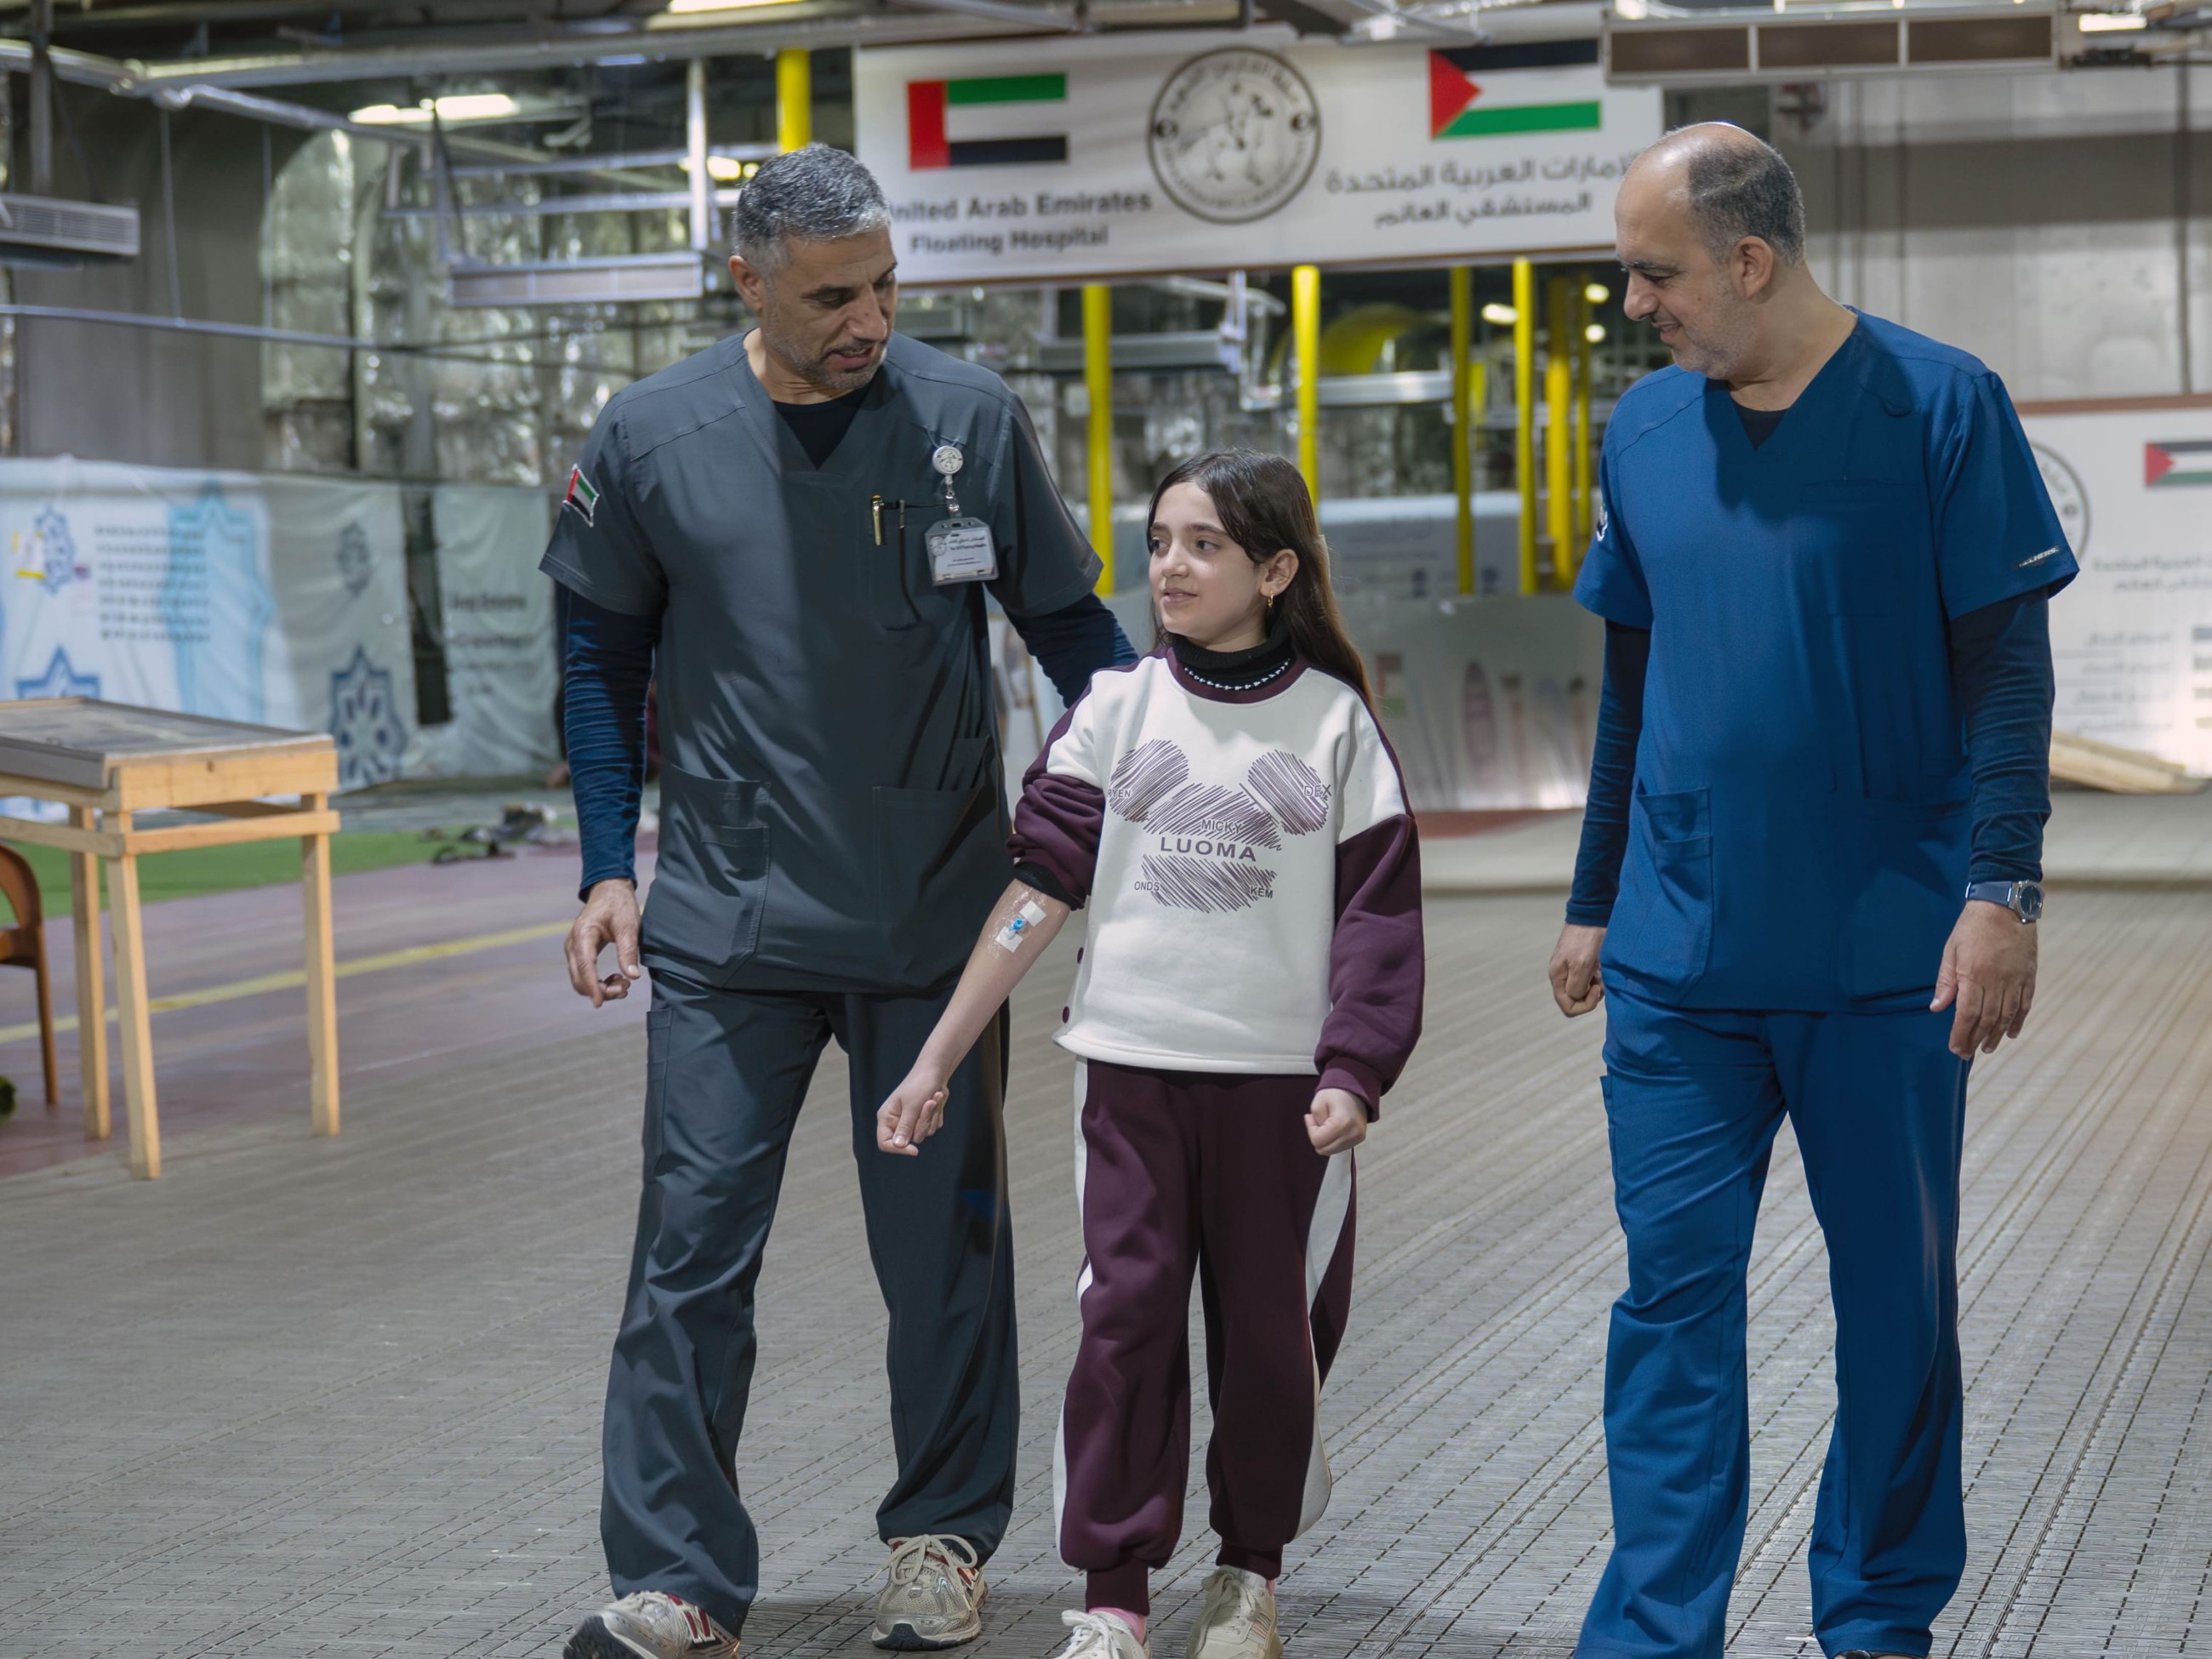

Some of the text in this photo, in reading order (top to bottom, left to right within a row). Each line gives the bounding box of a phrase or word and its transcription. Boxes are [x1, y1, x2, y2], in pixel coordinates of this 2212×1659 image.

[1324, 164, 1434, 195] المتحدة
[890, 191, 1152, 222] nited Arab Emirates
[910, 225, 1109, 255] Floating Hospital
[1304, 784, 1331, 797] DEX
[1160, 836, 1257, 862] LUOMA
[1250, 886, 1274, 899] KEM
